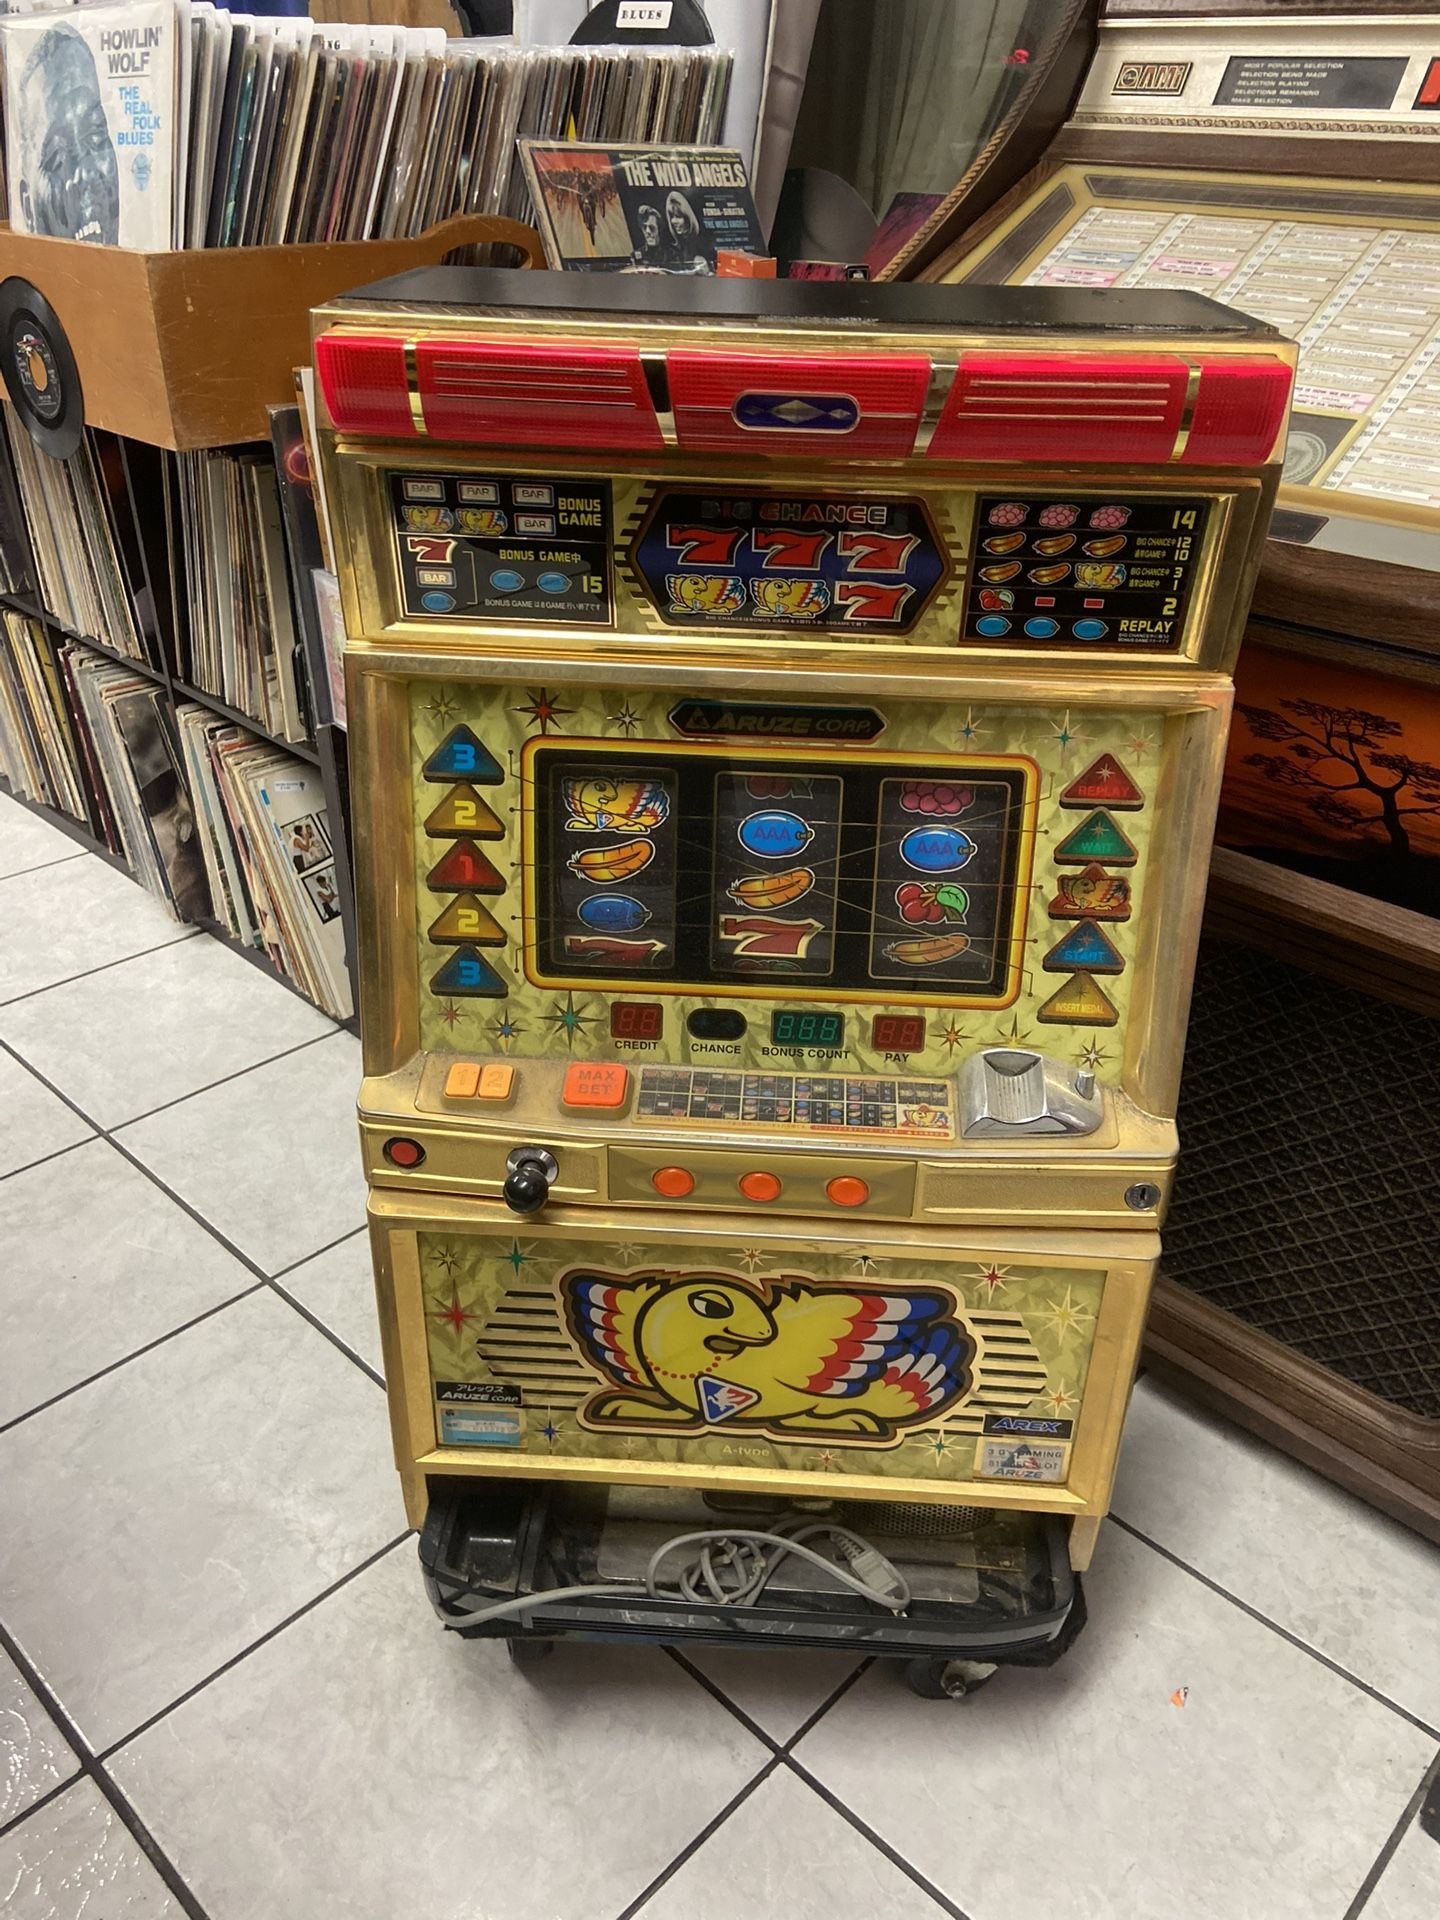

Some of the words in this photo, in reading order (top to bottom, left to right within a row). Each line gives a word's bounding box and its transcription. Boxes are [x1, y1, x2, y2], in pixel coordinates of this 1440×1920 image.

[621, 9, 663, 21] BLUES
[101, 28, 162, 51] HOWLIN'
[108, 52, 150, 73] WOLF
[119, 88, 140, 100] THE
[124, 99, 152, 115] REAL
[132, 116, 160, 130] FOLK
[118, 131, 153, 145] BLUES
[624, 162, 654, 186] THE
[652, 162, 691, 187] WILD
[693, 163, 747, 187] ANGELS
[410, 484, 435, 494] BAR
[466, 486, 490, 497] BAR
[522, 489, 545, 499] BAR
[558, 497, 601, 512] BONUS
[559, 512, 602, 527] GAME
[760, 503, 887, 525] CHANCE
[1172, 510, 1197, 530] 14
[524, 519, 547, 529] BAR
[1176, 537, 1192, 549] 12
[499, 549, 534, 561] BONUS
[1174, 550, 1189, 561] 10
[423, 573, 447, 583] BAR
[1173, 567, 1183, 578] 3
[582, 575, 603, 593] 15
[485, 598, 510, 608] BONUS
[1162, 597, 1178, 616] 2
[1120, 620, 1173, 635] REPLAY
[711, 712, 812, 733] ARUZE
[452, 743, 476, 770] 3
[1078, 785, 1131, 798] REPLAY
[454, 800, 476, 826] 2
[1081, 842, 1114, 854] WAIT
[459, 855, 474, 881] 1
[457, 908, 480, 933] 2
[1064, 951, 1106, 963] START
[458, 960, 480, 986] 3
[1055, 1002, 1079, 1014] INSERT
[614, 1040, 659, 1051] CREDIT
[691, 1043, 741, 1054] CHANCE
[761, 1047, 805, 1059] BONUS
[807, 1049, 850, 1060] COUNT
[884, 1052, 910, 1063] PAY
[456, 1069, 469, 1086] 1
[487, 1071, 504, 1087] 2
[578, 1070, 615, 1081] MAX
[578, 1084, 611, 1096] BET
[456, 1384, 504, 1393] アレックス
[441, 1391, 490, 1401] ARUZE
[992, 1417, 1062, 1432] AREX
[993, 1468, 1044, 1479] ARUZE
